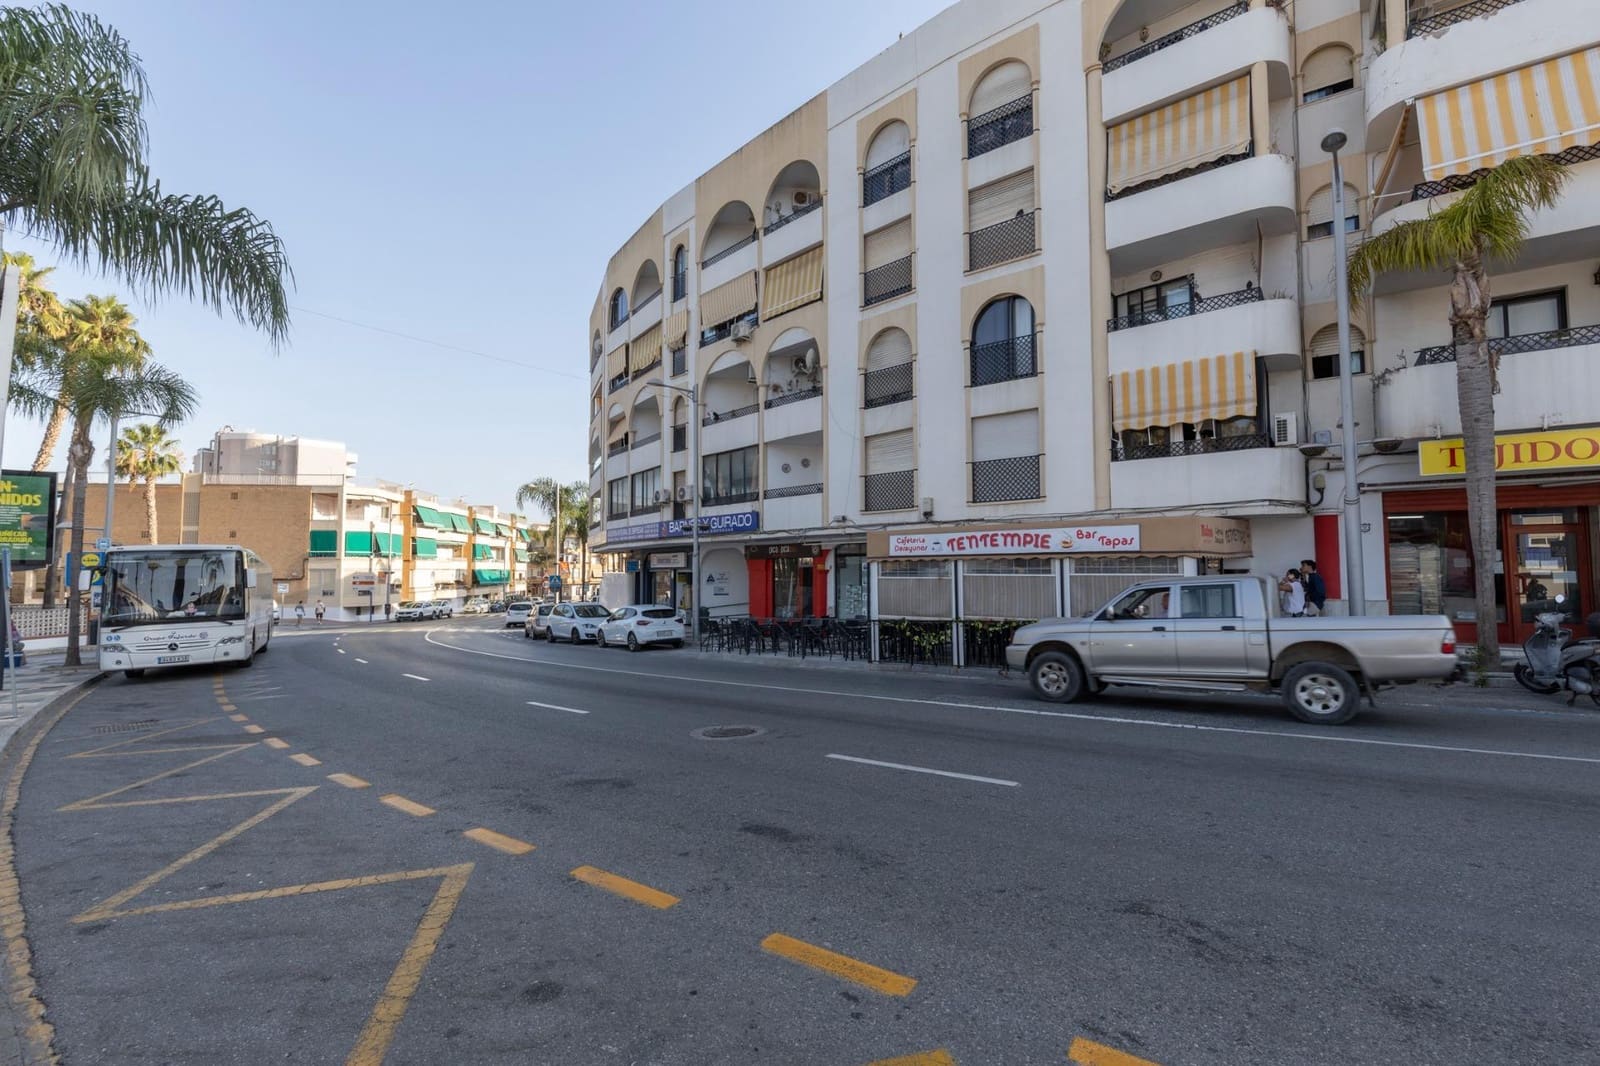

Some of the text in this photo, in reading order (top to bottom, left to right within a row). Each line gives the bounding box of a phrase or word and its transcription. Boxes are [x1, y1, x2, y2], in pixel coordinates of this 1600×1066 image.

[1439, 437, 1600, 470] TJIDO
[947, 532, 1052, 551] TENTEMPIE
[1076, 528, 1097, 540] Bar
[1098, 535, 1135, 549] Tapas
